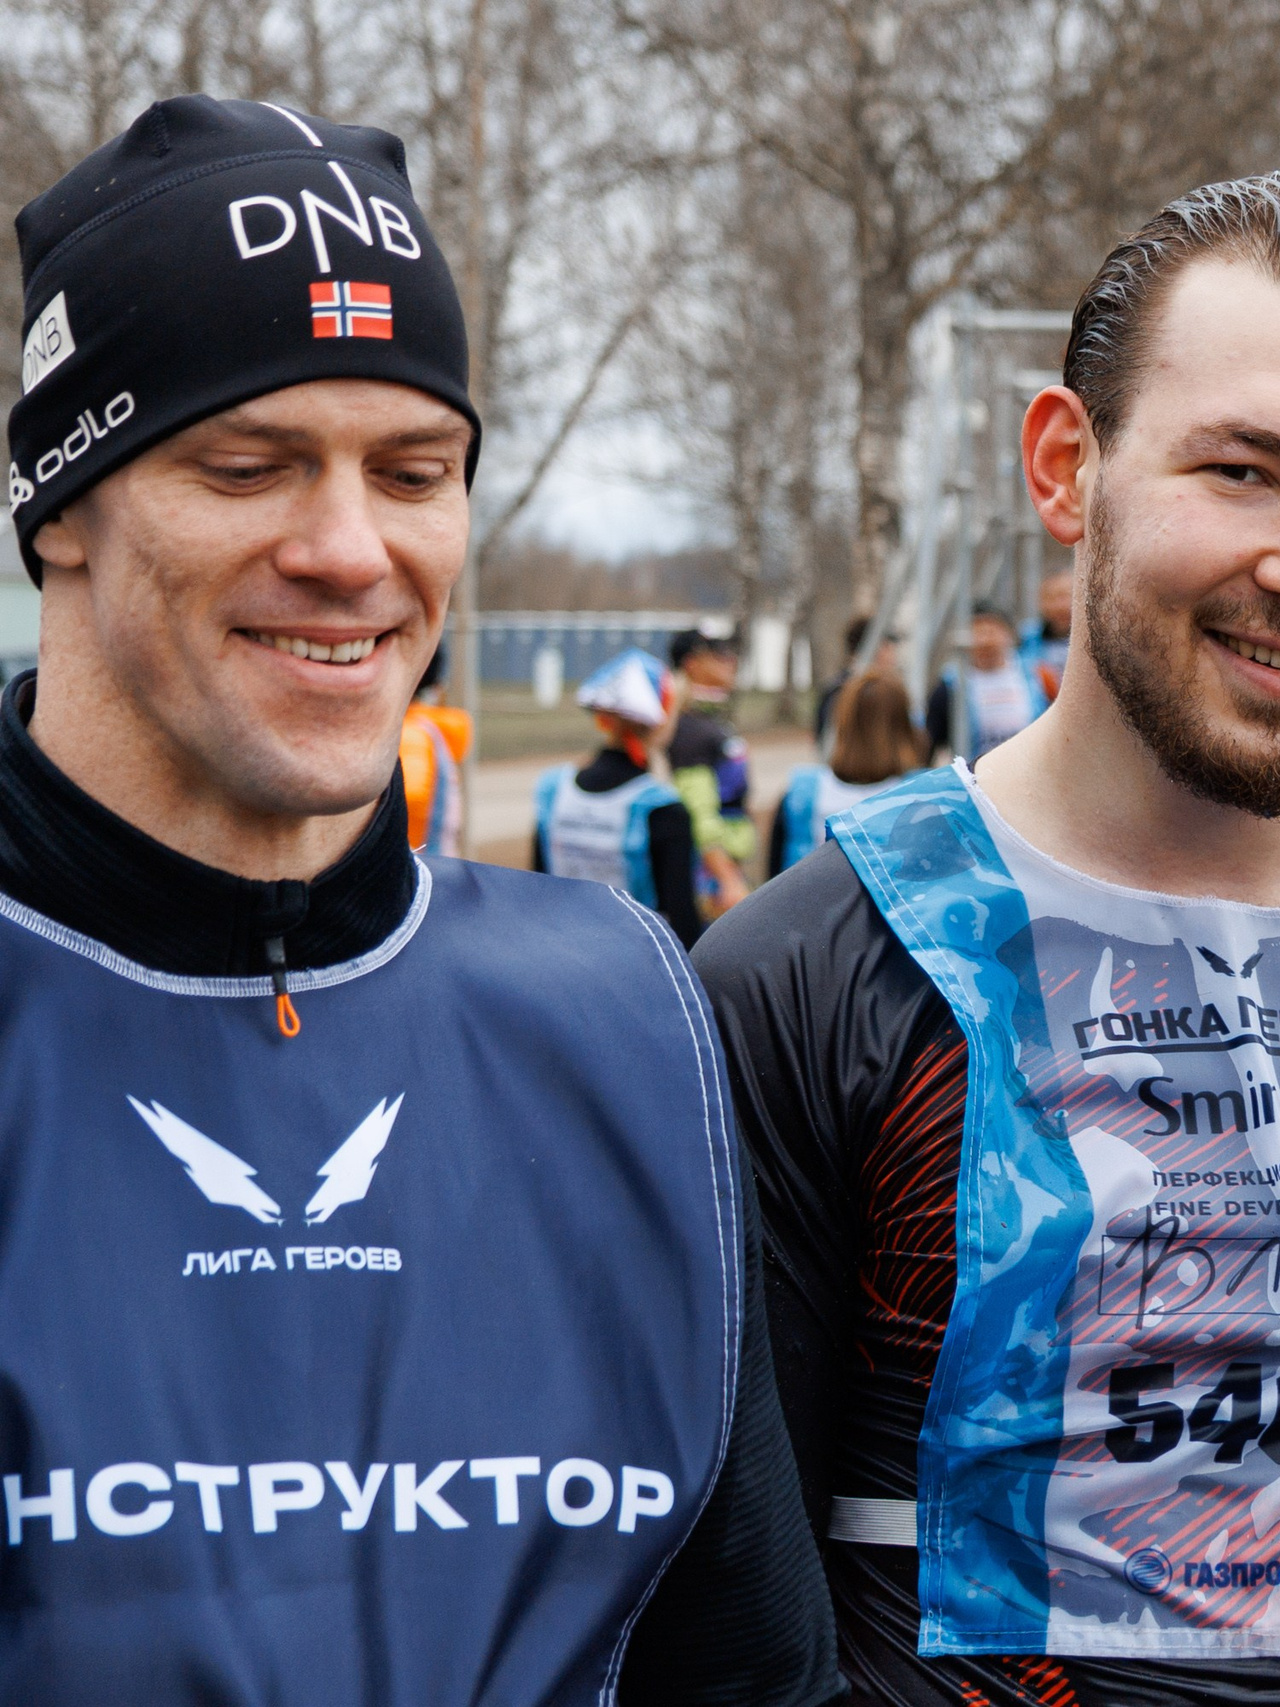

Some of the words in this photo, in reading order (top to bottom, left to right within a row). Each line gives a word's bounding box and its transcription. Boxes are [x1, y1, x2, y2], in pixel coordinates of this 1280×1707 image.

[228, 160, 422, 273] DNB
[36, 391, 135, 484] odlo
[1072, 1002, 1230, 1049] ГОНКА
[1155, 1200, 1213, 1216] FINE
[182, 1247, 278, 1277] ЛИГА
[286, 1246, 403, 1273] ГЕРОЕВ
[2, 1456, 676, 1546] НСТРУКТОР
